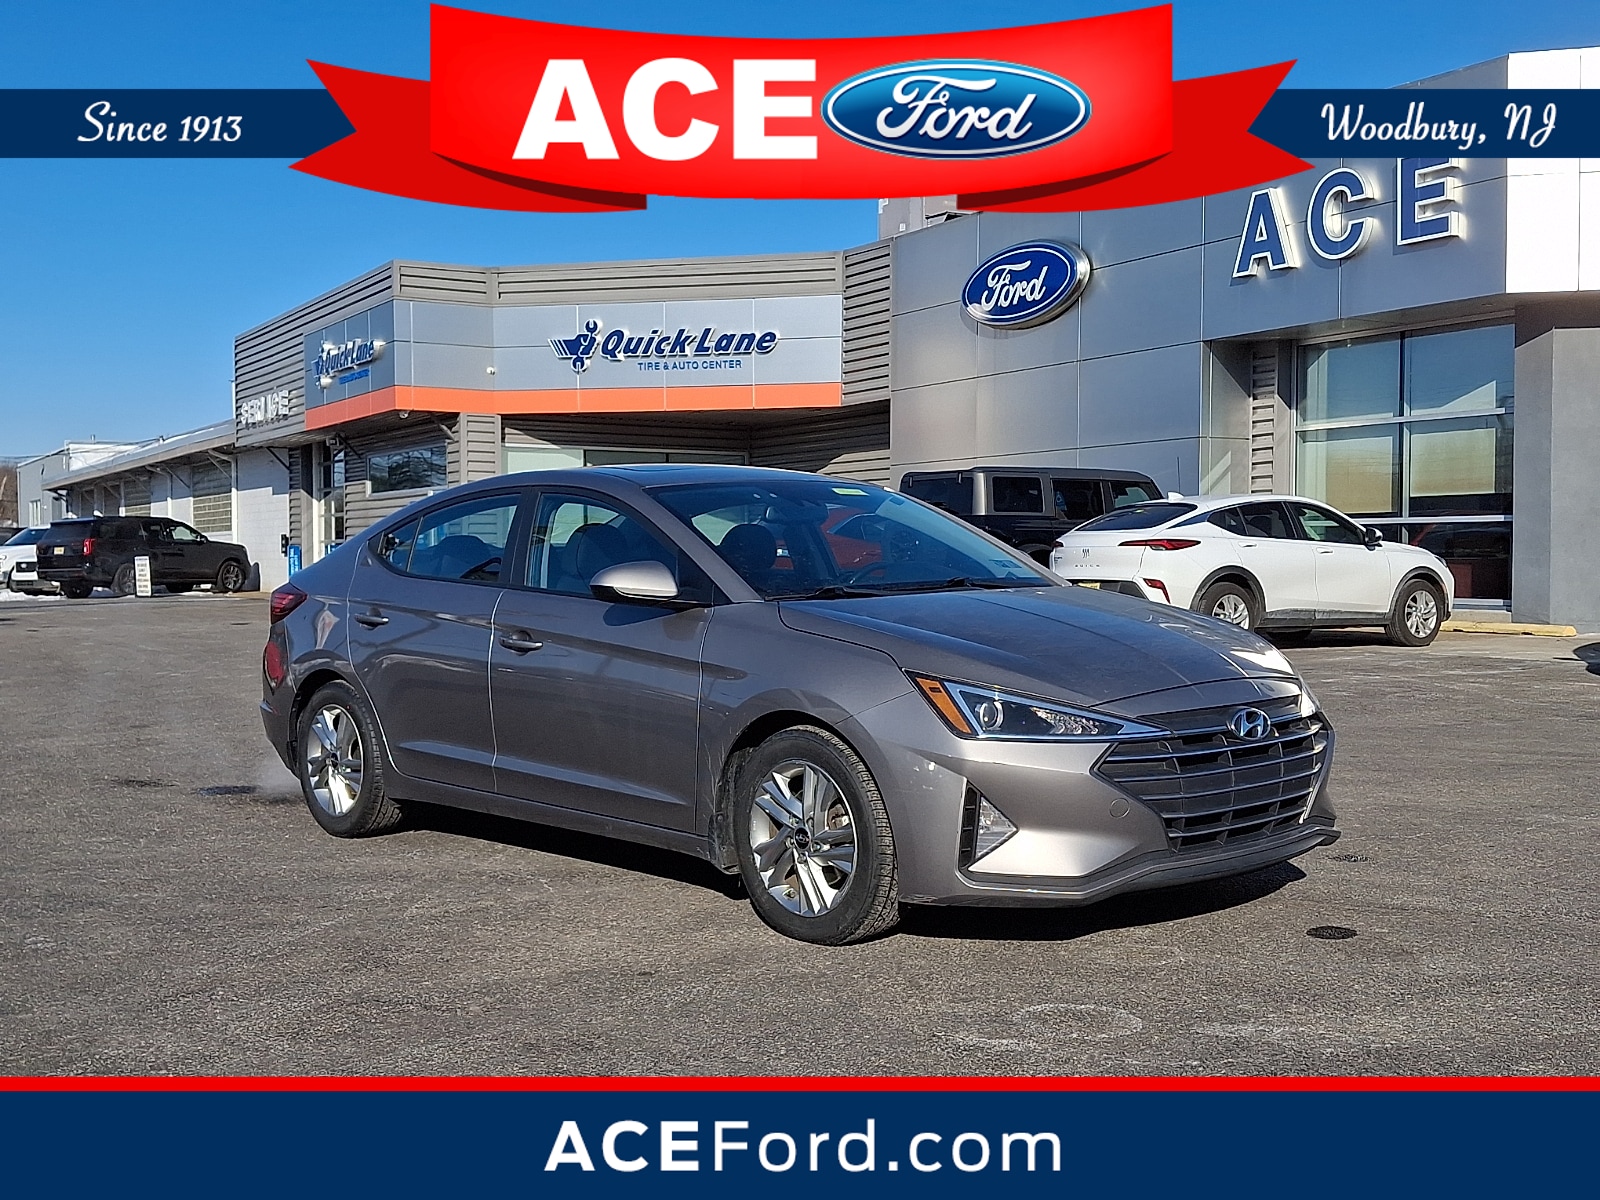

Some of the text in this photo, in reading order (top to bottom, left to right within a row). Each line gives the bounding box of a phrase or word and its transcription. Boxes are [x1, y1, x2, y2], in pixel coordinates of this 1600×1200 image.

[1232, 157, 1461, 278] ACE
[981, 259, 1048, 312] Ford
[600, 326, 779, 361] Quick Lane
[637, 359, 742, 371] TIRE & AUTO CENTER
